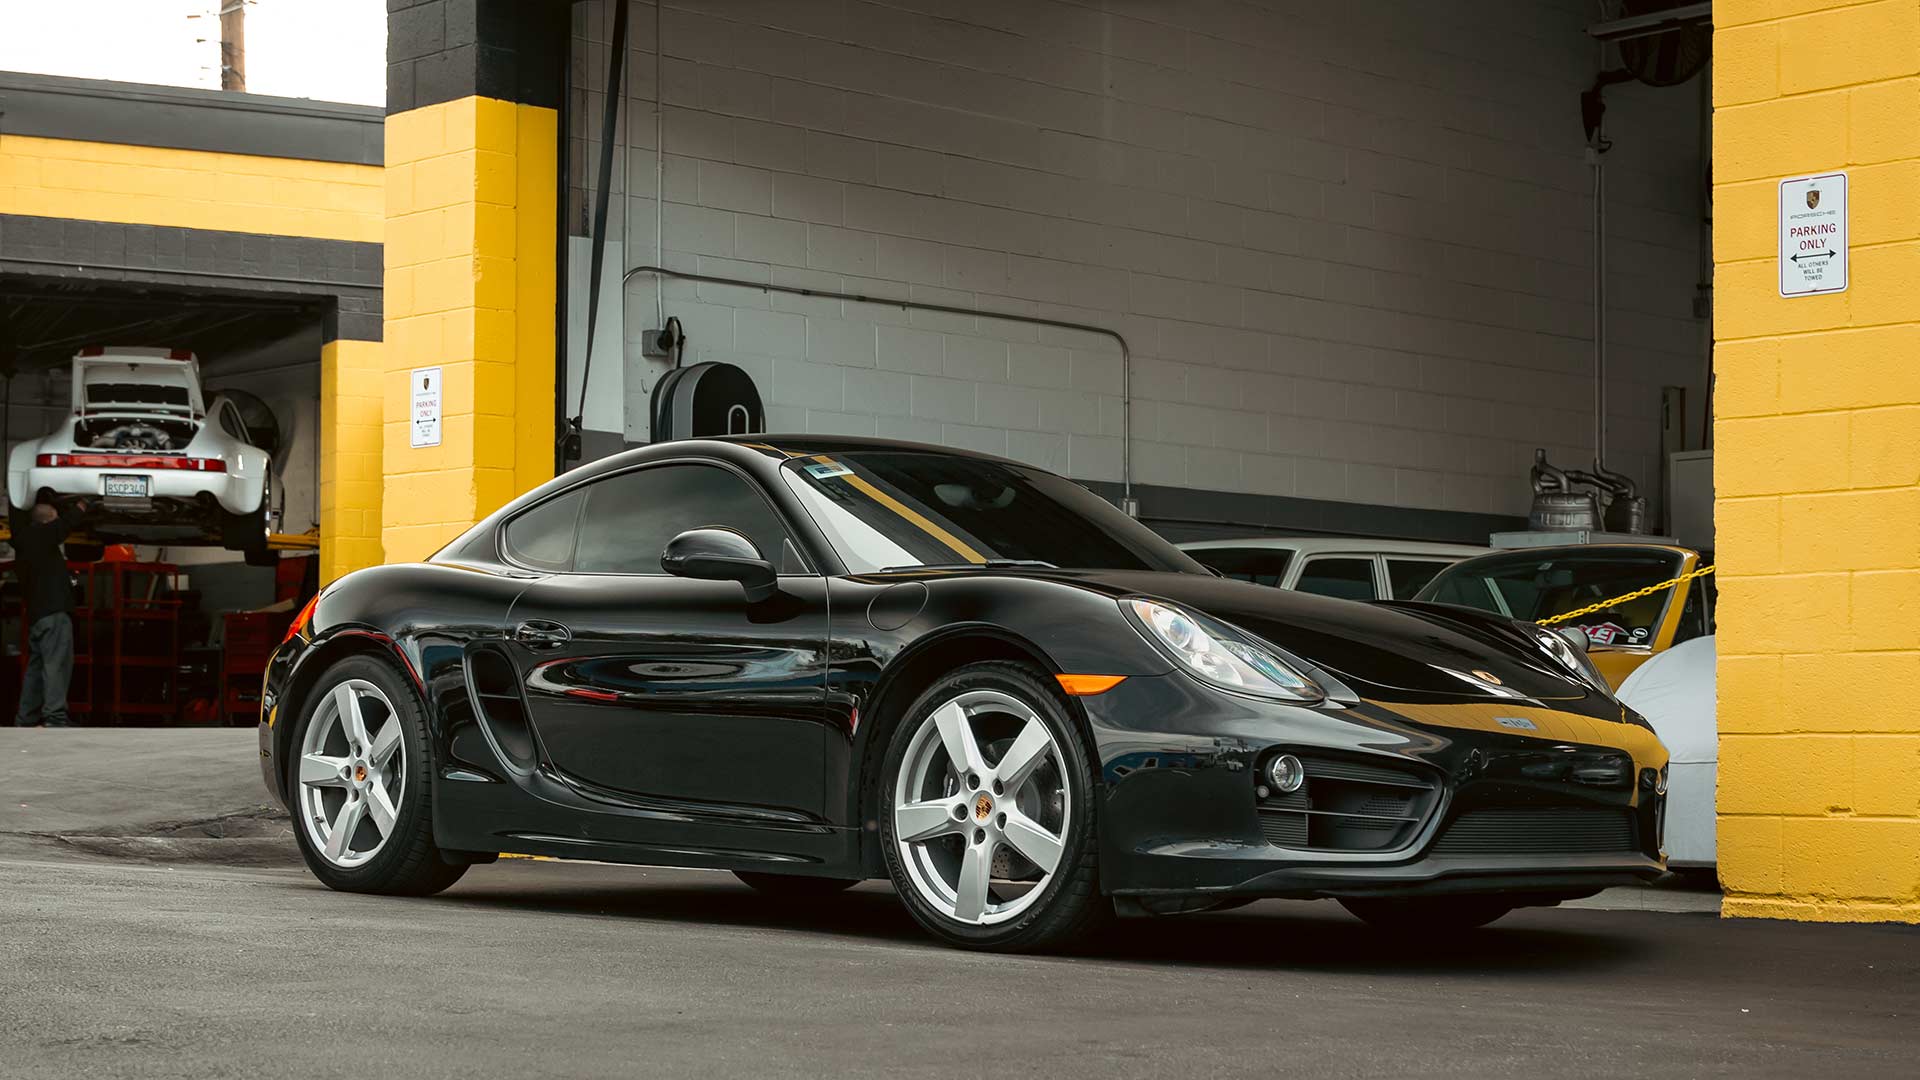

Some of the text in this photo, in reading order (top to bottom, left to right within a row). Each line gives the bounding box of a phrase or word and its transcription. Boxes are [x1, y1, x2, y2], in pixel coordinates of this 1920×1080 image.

[1790, 210, 1836, 219] PORSCHE
[1790, 223, 1836, 238] PARKING
[1800, 238, 1827, 250] ONLY
[1808, 260, 1829, 268] OTHERS
